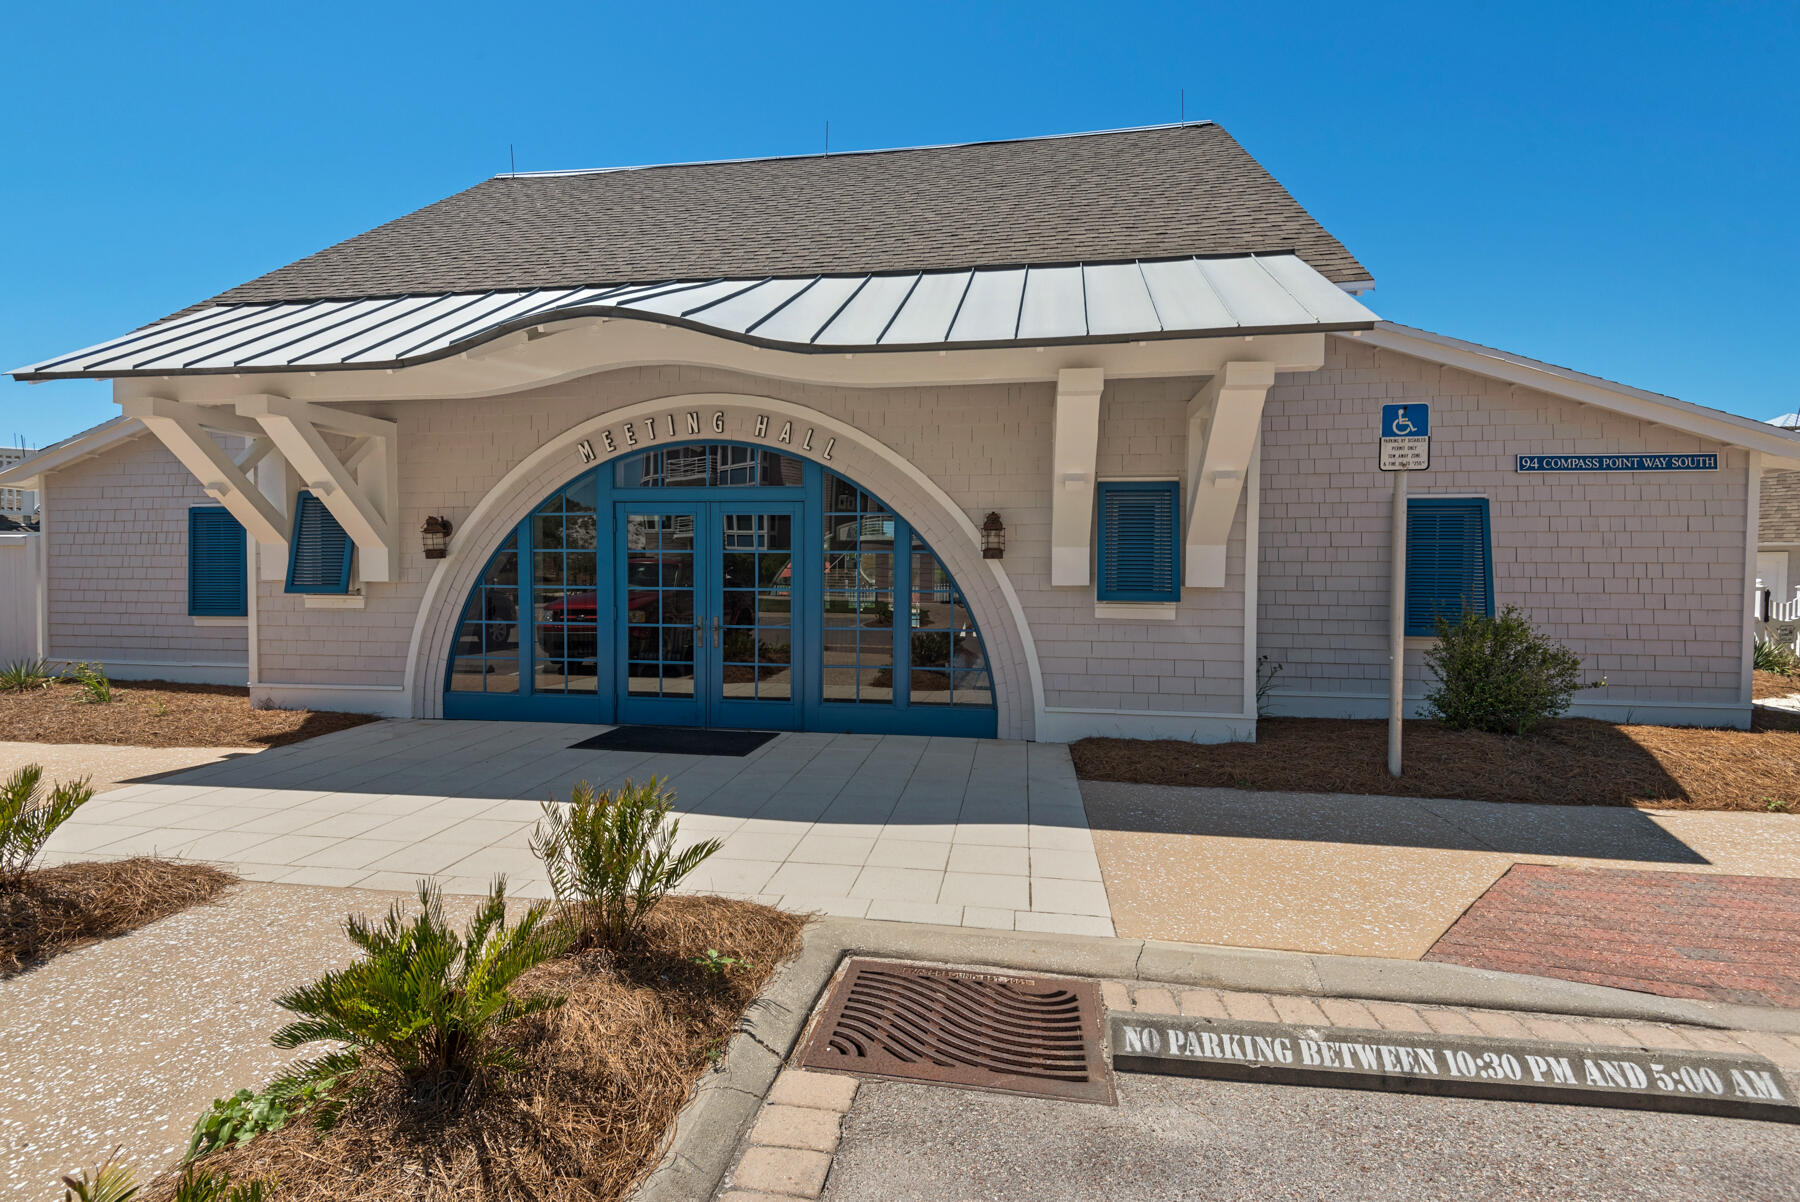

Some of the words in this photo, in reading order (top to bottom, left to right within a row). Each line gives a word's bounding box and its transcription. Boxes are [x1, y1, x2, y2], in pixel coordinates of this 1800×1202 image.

[577, 410, 725, 464] MEETING
[754, 415, 836, 461] HALL
[1521, 457, 1539, 470] 94
[1543, 457, 1599, 470] COMPASS
[1603, 457, 1640, 469] POINT
[1643, 456, 1669, 468] WAY
[1671, 456, 1715, 468] SOUTH
[1123, 1026, 1161, 1054] NO
[1166, 1029, 1294, 1065] PARKING
[1298, 1038, 1439, 1077] BETWEEN
[1443, 1049, 1522, 1083] 10:30
[1527, 1055, 1578, 1086] PM
[1583, 1058, 1649, 1091] AND
[1652, 1064, 1725, 1095] 5:00
[1731, 1069, 1785, 1102] AM
